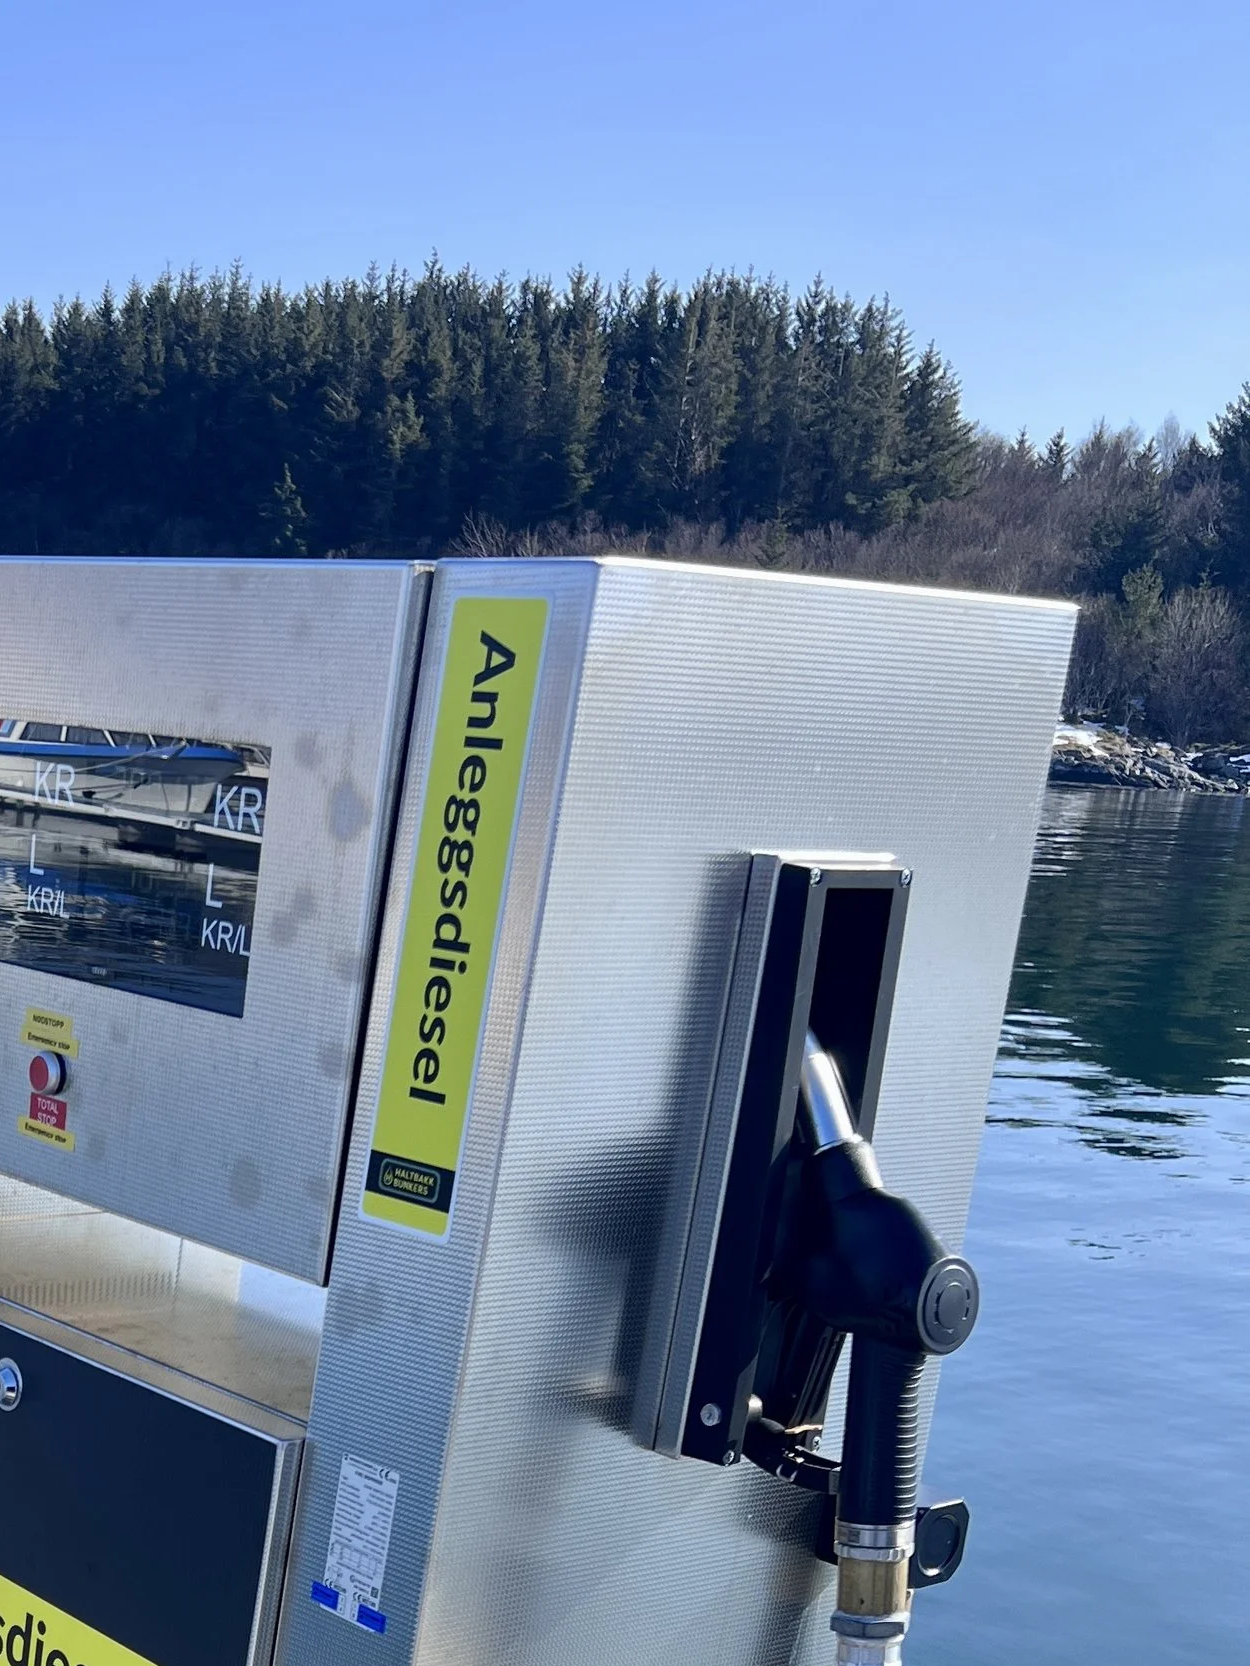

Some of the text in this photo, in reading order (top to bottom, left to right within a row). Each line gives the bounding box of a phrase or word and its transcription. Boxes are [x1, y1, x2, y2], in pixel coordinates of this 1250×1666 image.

[34, 760, 76, 806] KR
[213, 783, 263, 834] KR
[29, 833, 45, 876] L
[408, 629, 518, 1106] Anleggsdiesel
[26, 883, 70, 919] KR/L
[205, 862, 223, 909] L
[200, 917, 251, 957] KR/L
[37, 1097, 59, 1115] TOTAL
[37, 1112, 57, 1127] STOP
[392, 1178, 429, 1196] BUNKERS
[394, 1167, 435, 1187] HALTBAKK
